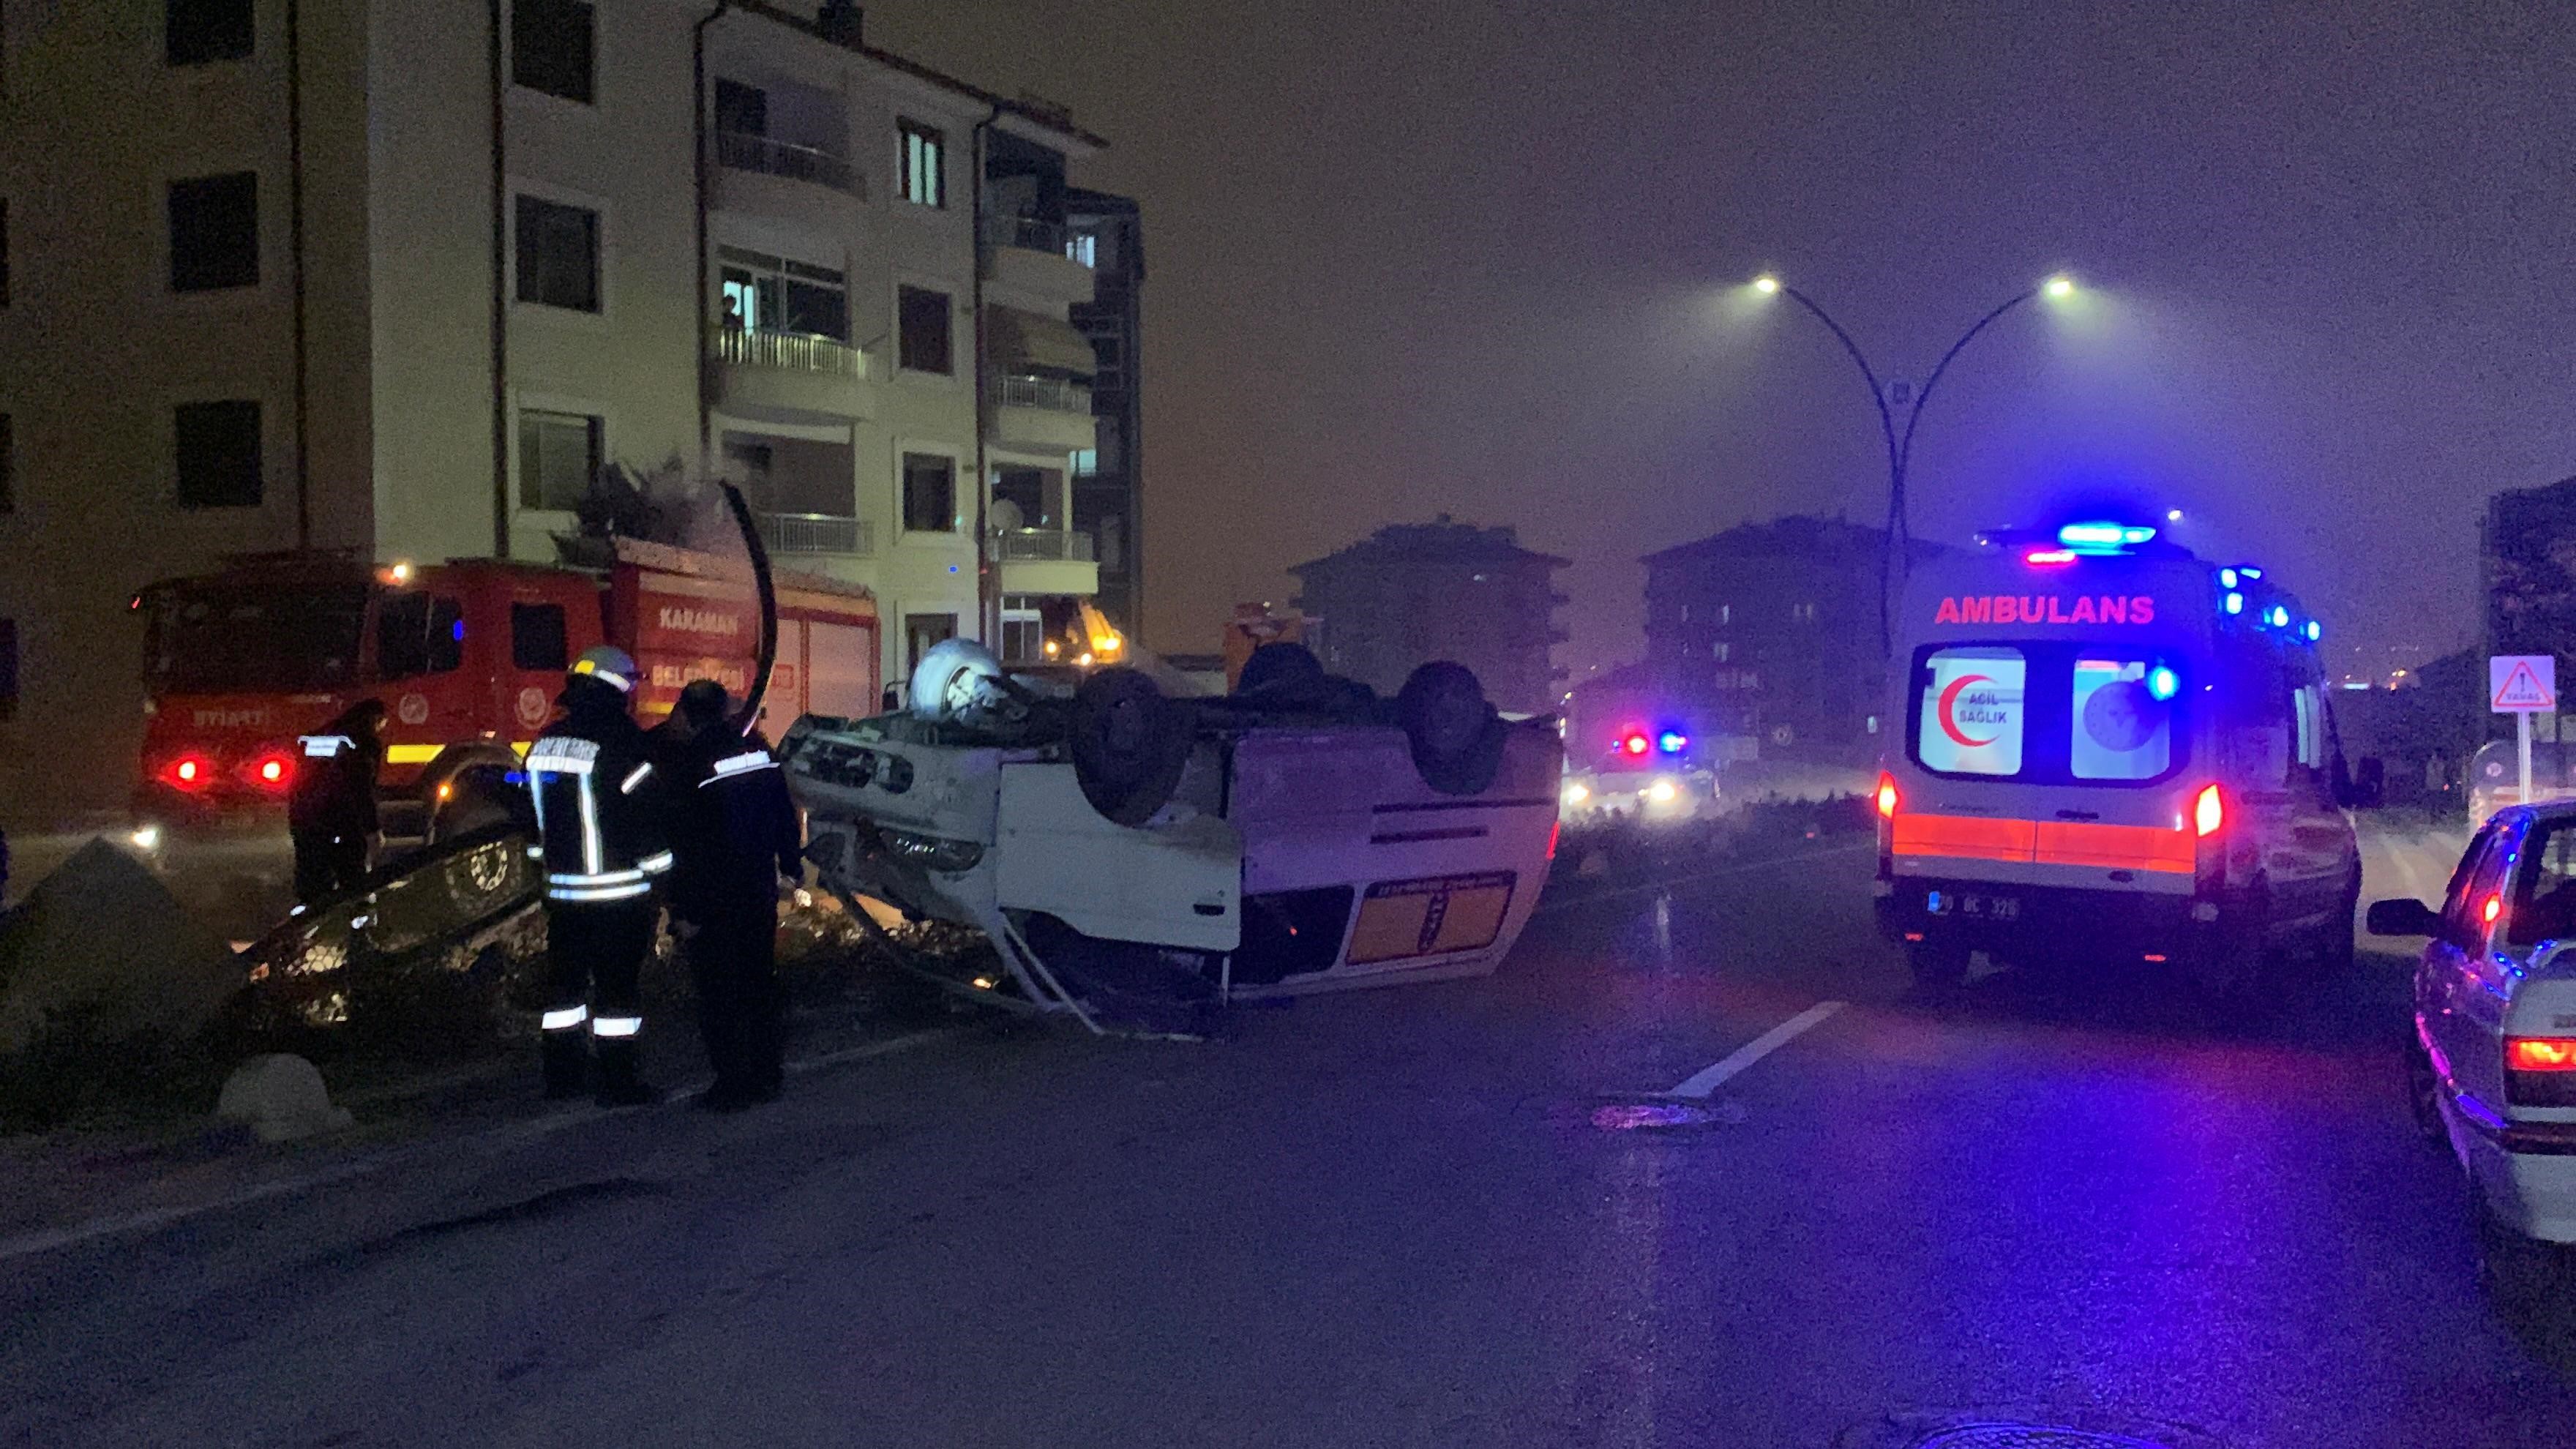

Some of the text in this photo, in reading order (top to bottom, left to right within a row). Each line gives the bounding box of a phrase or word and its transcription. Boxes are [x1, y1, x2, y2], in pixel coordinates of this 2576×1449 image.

[659, 607, 739, 634] KARAMAN
[1934, 596, 2155, 624] AMBULANS
[1969, 690, 1999, 705] ACİL
[1959, 708, 2007, 724] SAĞLIK
